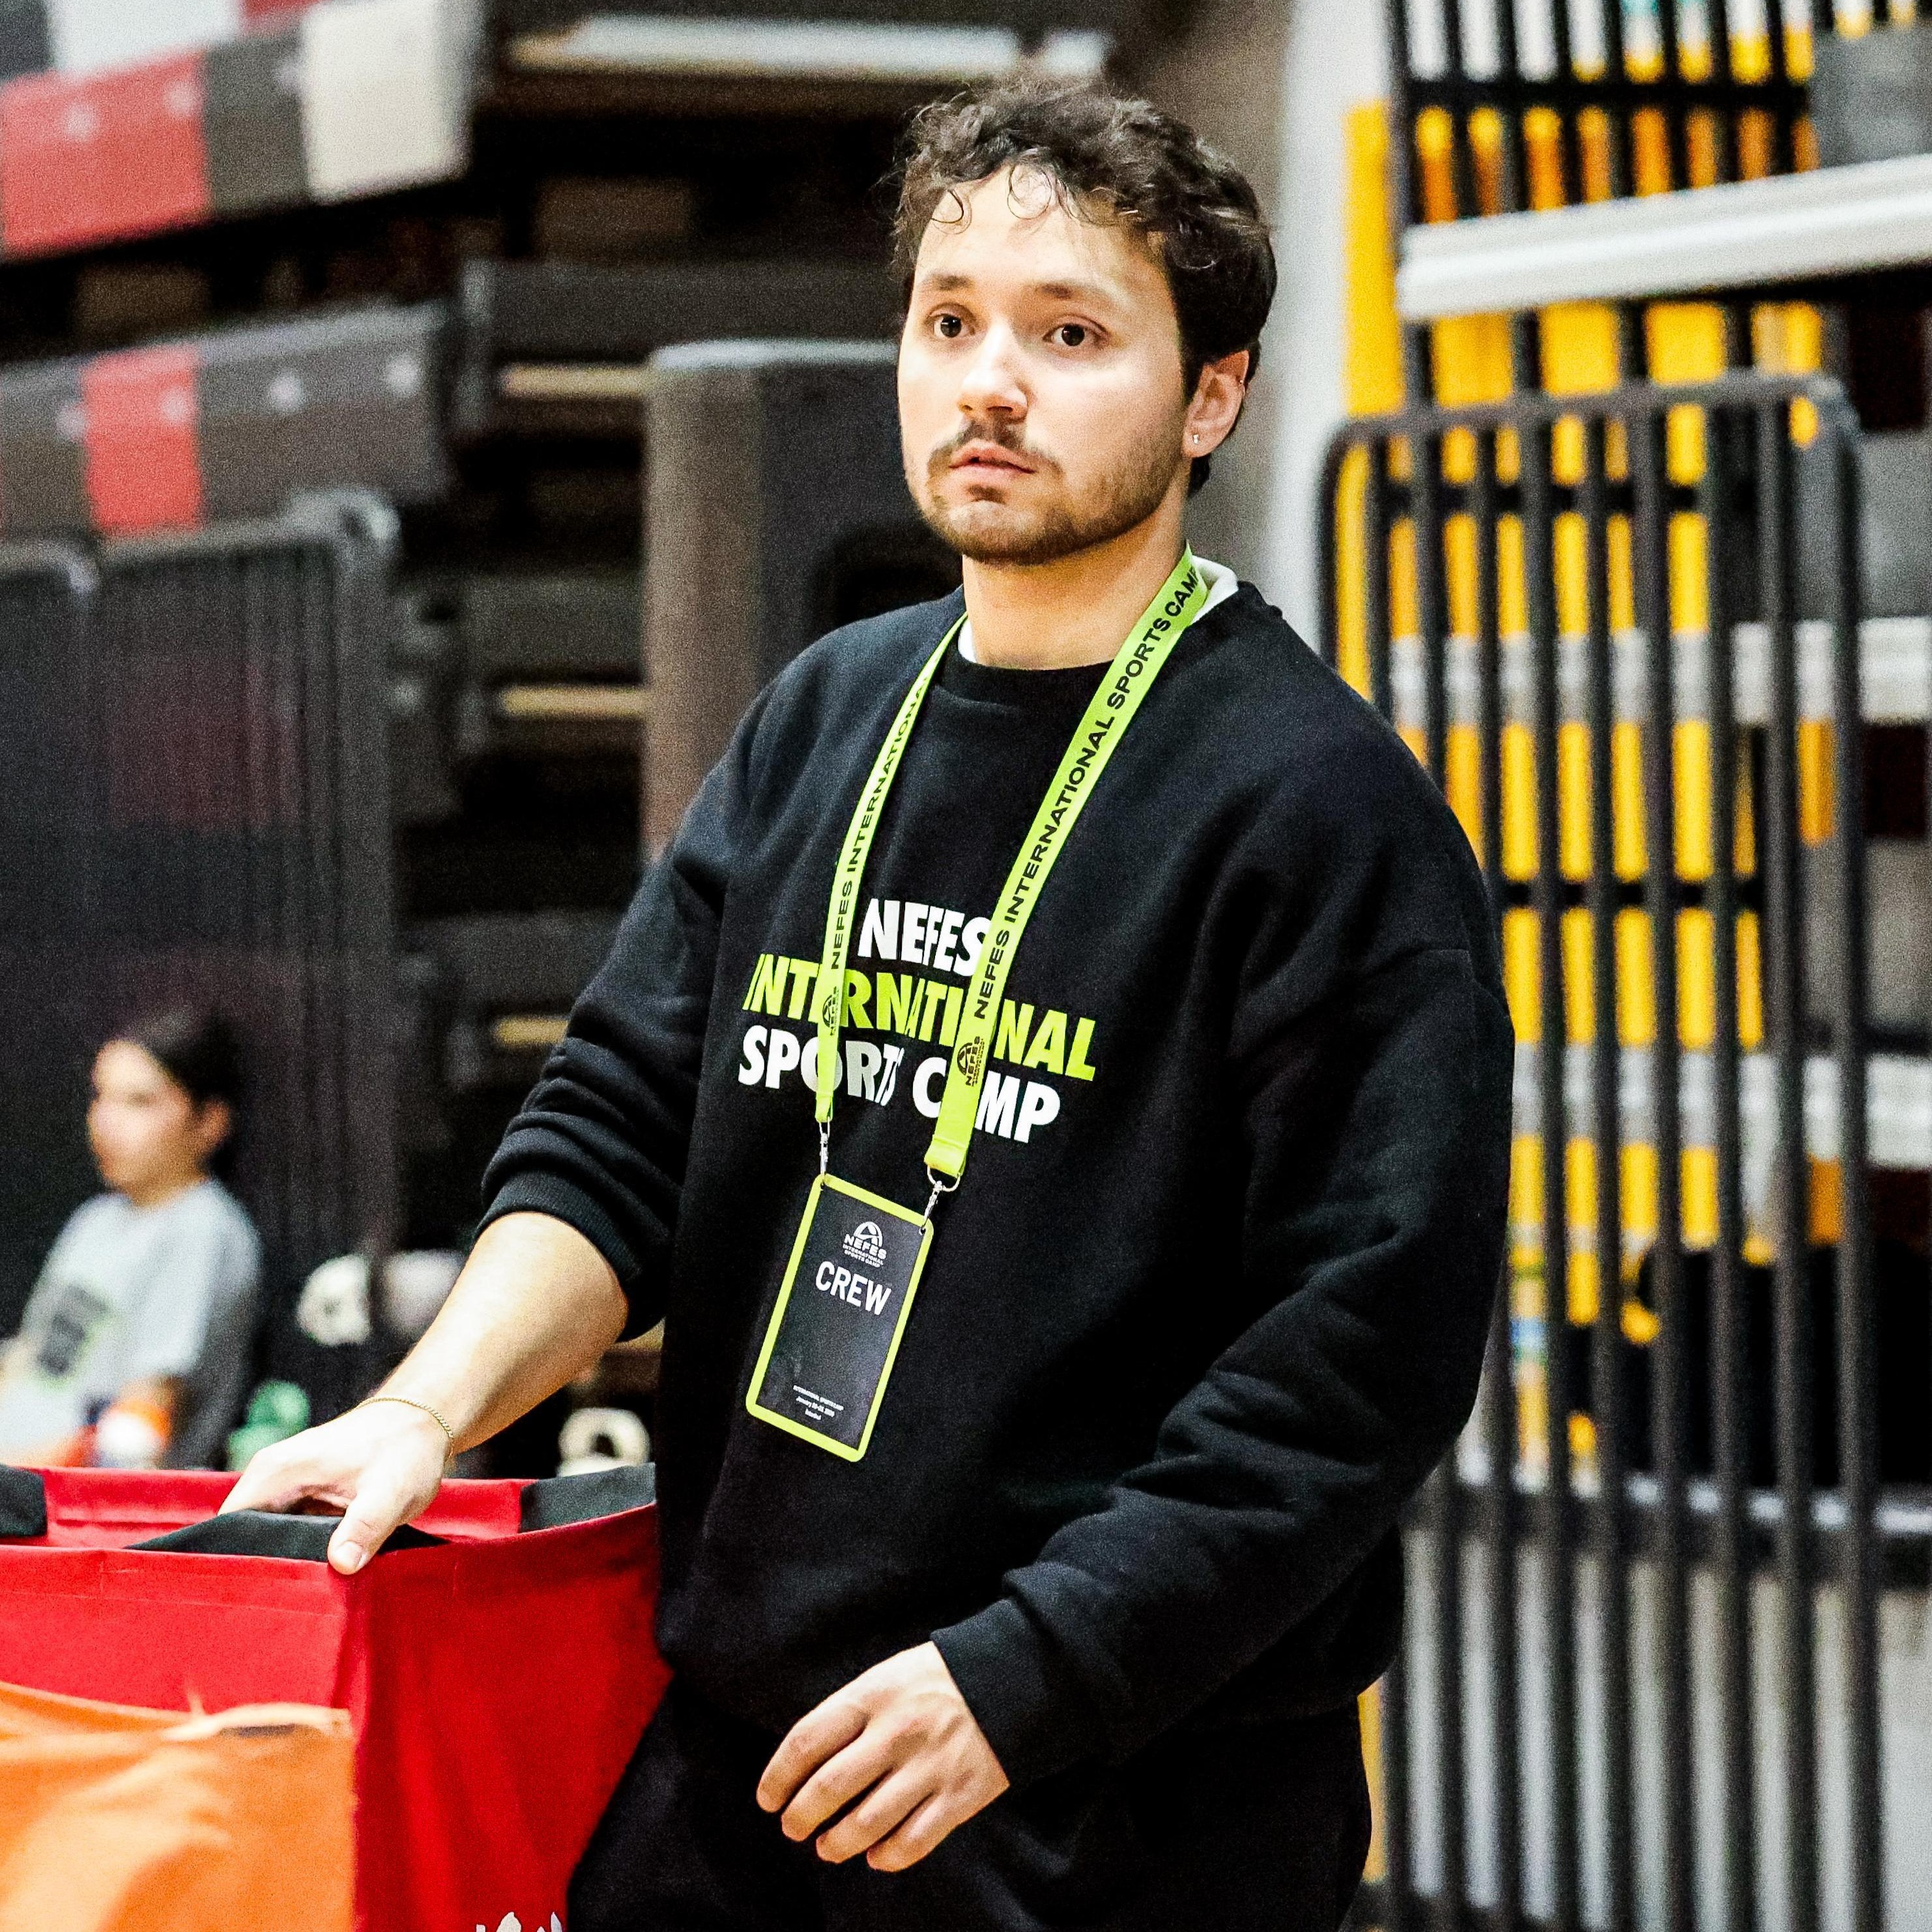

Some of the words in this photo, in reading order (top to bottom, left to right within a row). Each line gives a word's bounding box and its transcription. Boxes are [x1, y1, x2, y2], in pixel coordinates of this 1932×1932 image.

[973, 929, 1010, 1019] NEFES
[1004, 716, 1115, 923] INTERNATIONAL
[1107, 617, 1172, 710] SPORTS
[831, 881, 853, 970] NEFES
[858, 898, 991, 977] NEFES
[742, 953, 1096, 1082] INTRNATINAL
[912, 1056, 1061, 1144] CMP
[815, 1260, 892, 1316] CREW
[844, 1233, 887, 1260] NEFES
